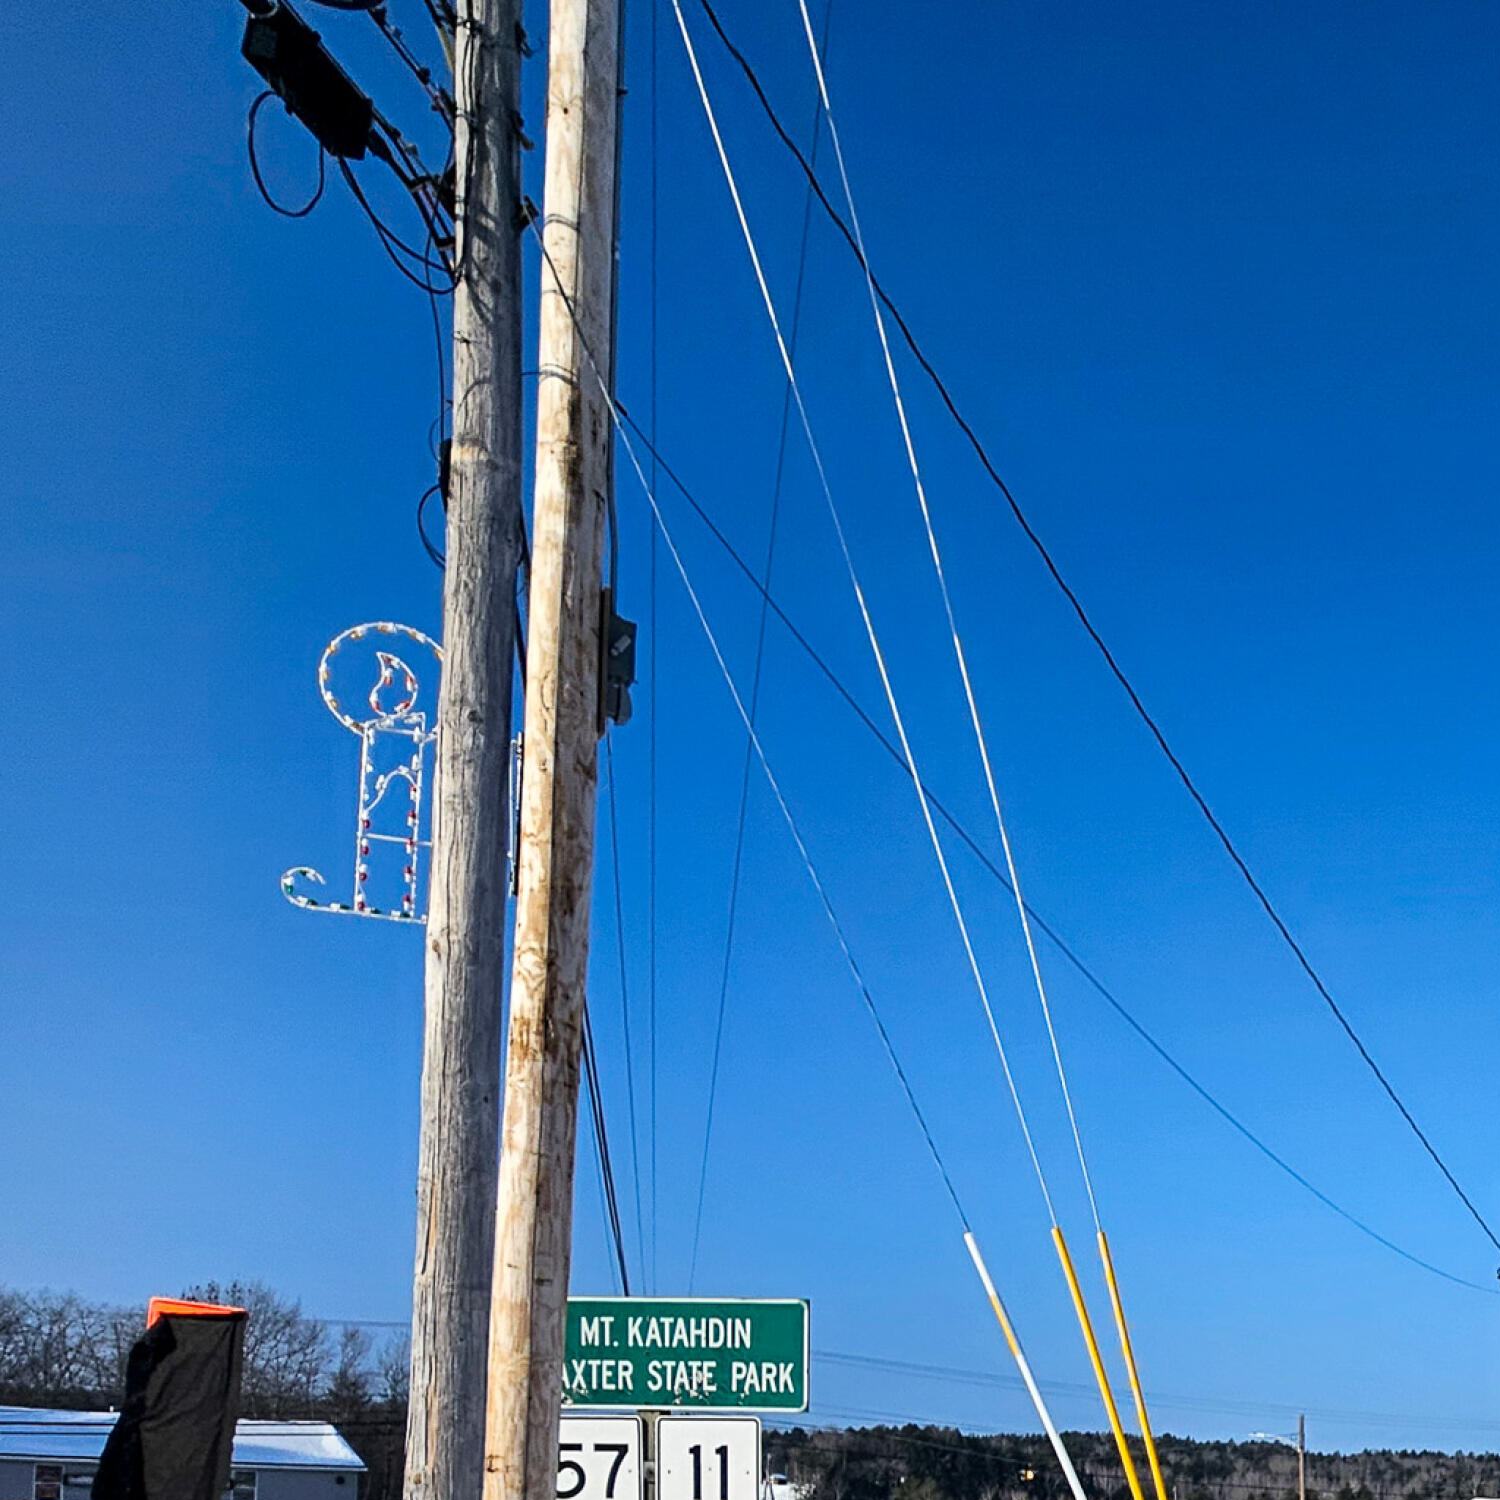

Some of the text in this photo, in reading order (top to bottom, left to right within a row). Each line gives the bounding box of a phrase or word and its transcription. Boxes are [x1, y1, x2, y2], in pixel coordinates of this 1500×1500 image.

[580, 1316, 751, 1349] MT. KATAHDIN
[646, 1360, 717, 1393] STATE
[730, 1361, 795, 1394] PARK
[556, 1443, 629, 1499] 57
[688, 1444, 729, 1500] 11
